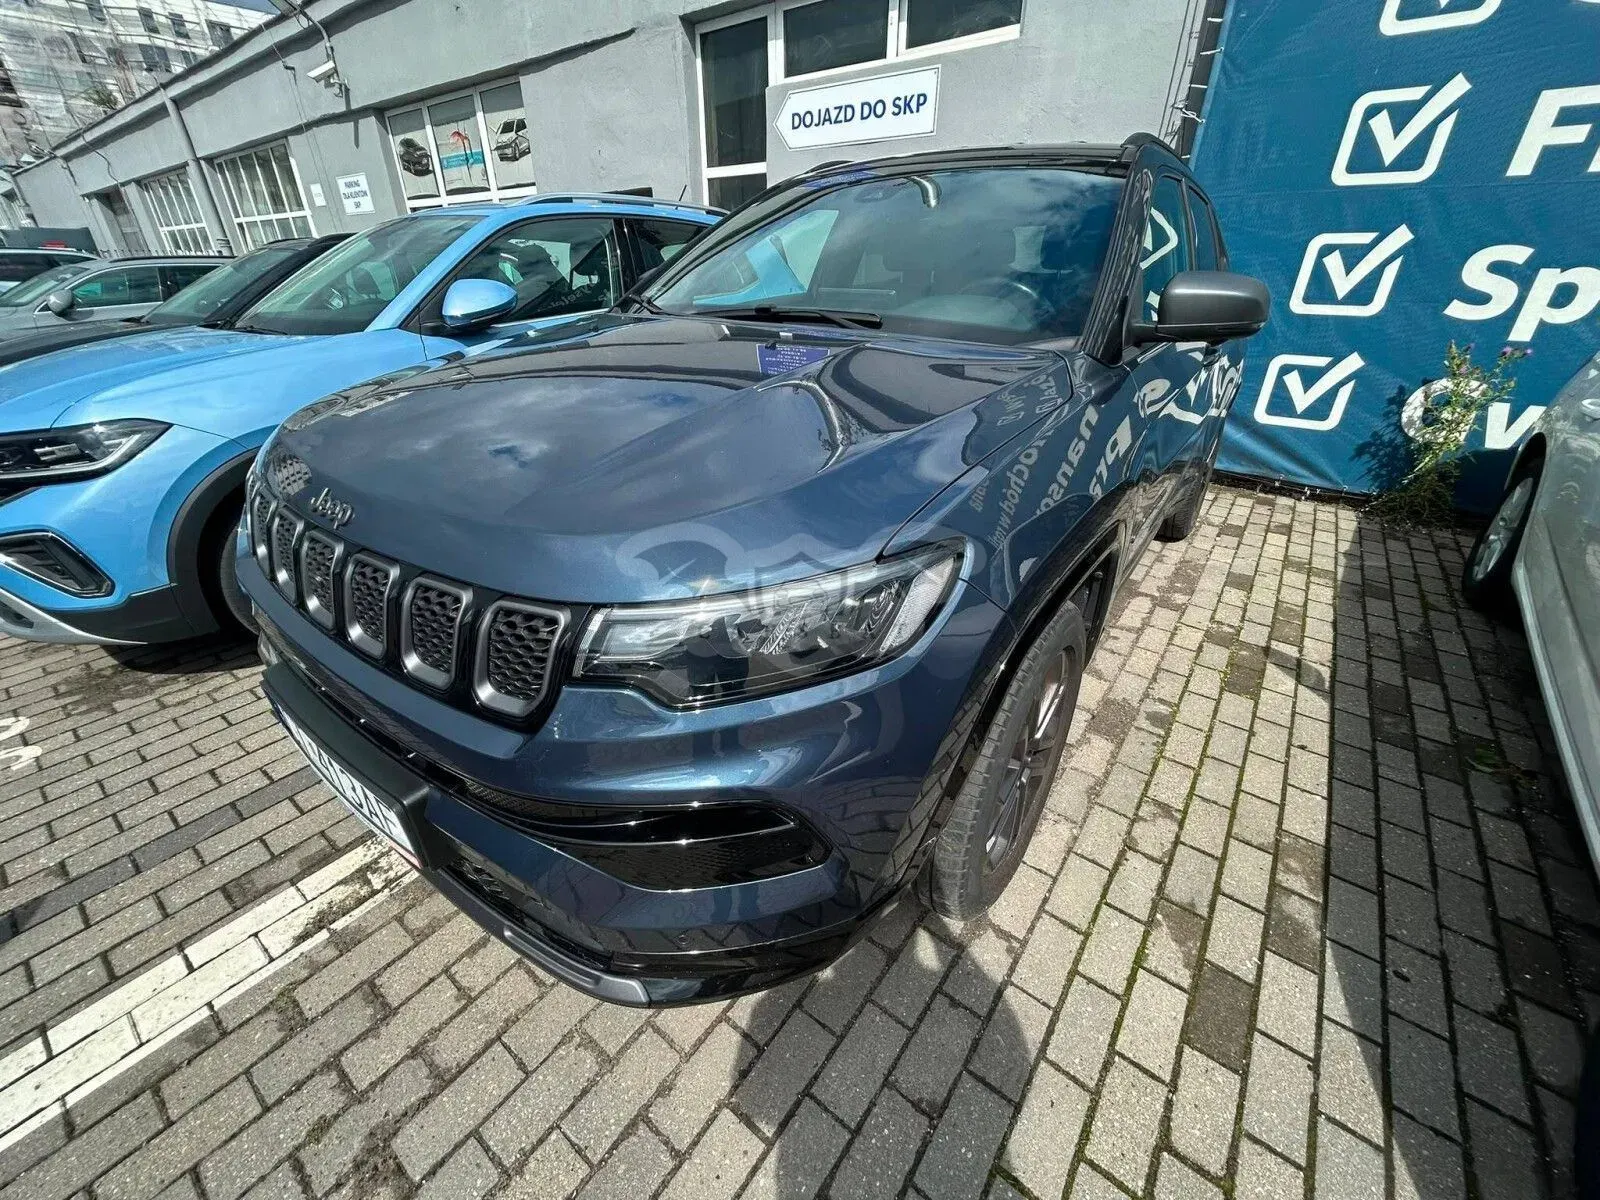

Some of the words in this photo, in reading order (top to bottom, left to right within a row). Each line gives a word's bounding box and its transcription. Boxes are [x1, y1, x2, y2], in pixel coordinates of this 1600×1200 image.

[791, 104, 855, 130] DOJAZD
[860, 99, 886, 121] DO
[891, 93, 928, 117] SKP
[1505, 84, 1600, 177] F
[310, 487, 353, 530] Jeep
